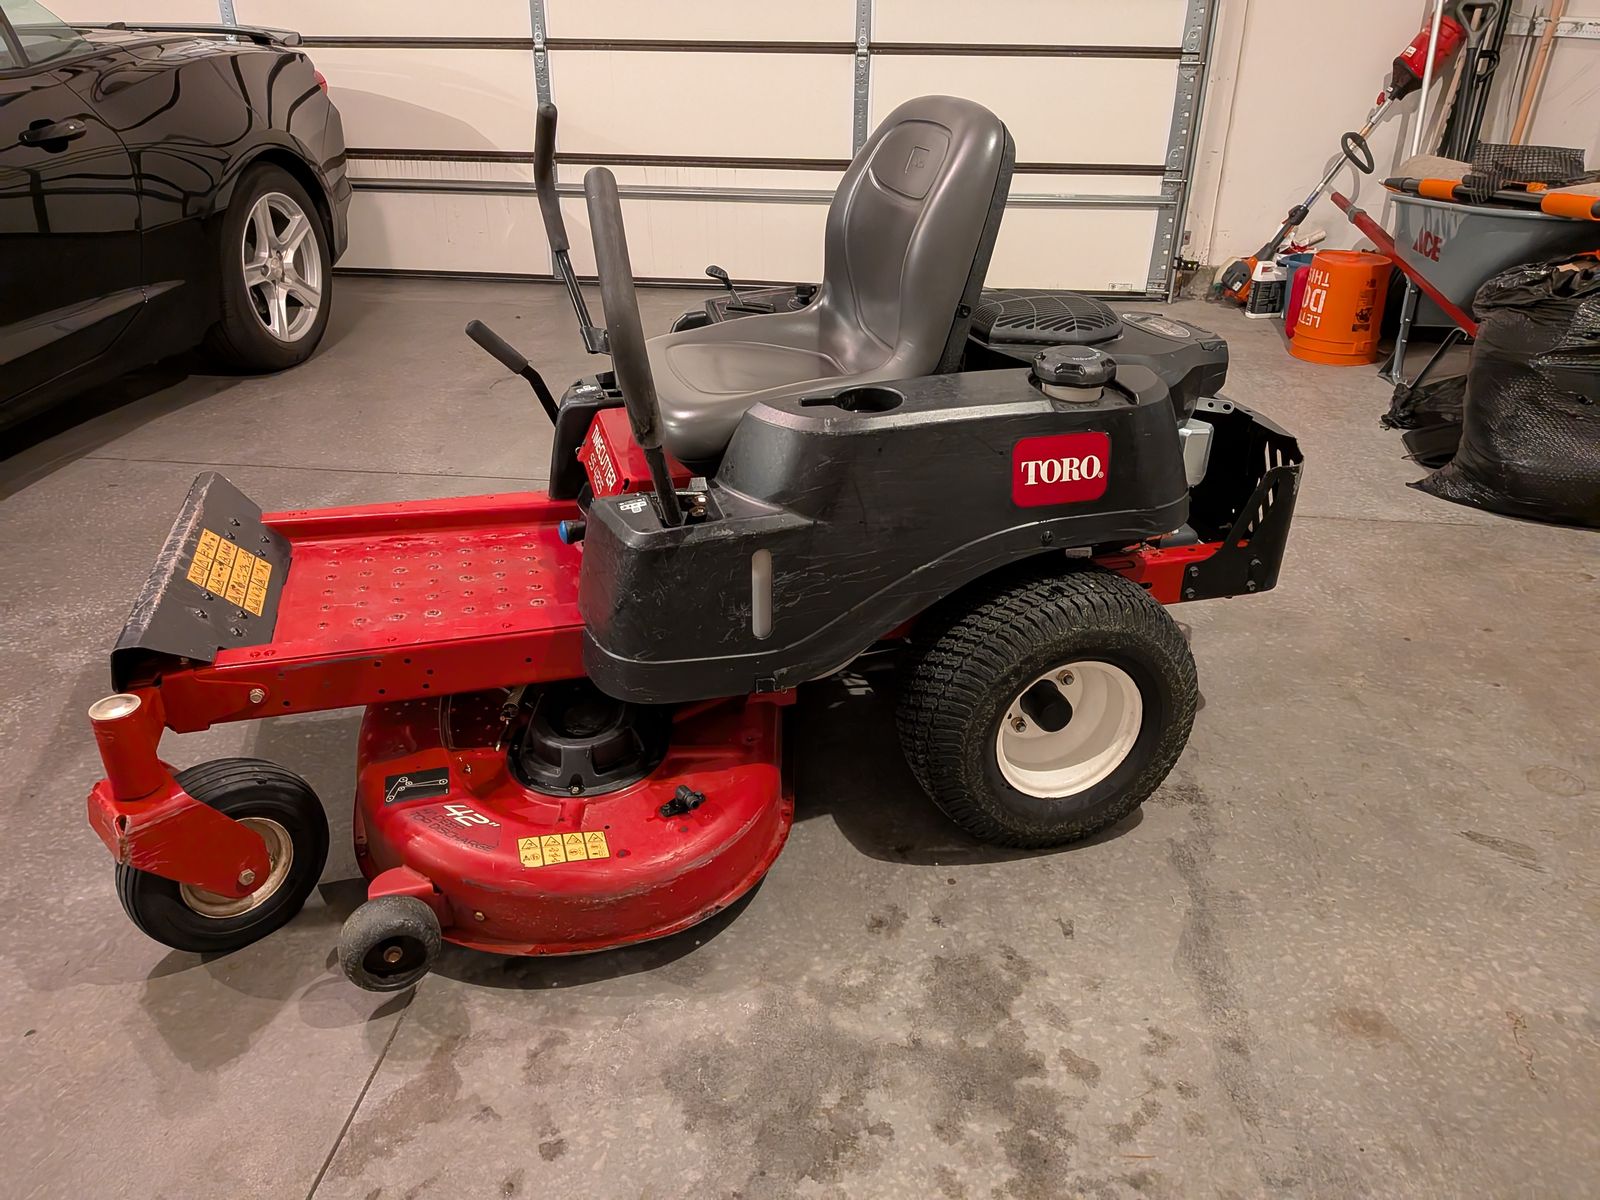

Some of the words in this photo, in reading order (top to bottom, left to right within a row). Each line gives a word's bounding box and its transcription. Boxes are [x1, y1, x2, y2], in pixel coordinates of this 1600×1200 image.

[1412, 225, 1442, 262] ACE
[1021, 455, 1101, 485] TORO
[429, 823, 496, 852] DISCHARGE
